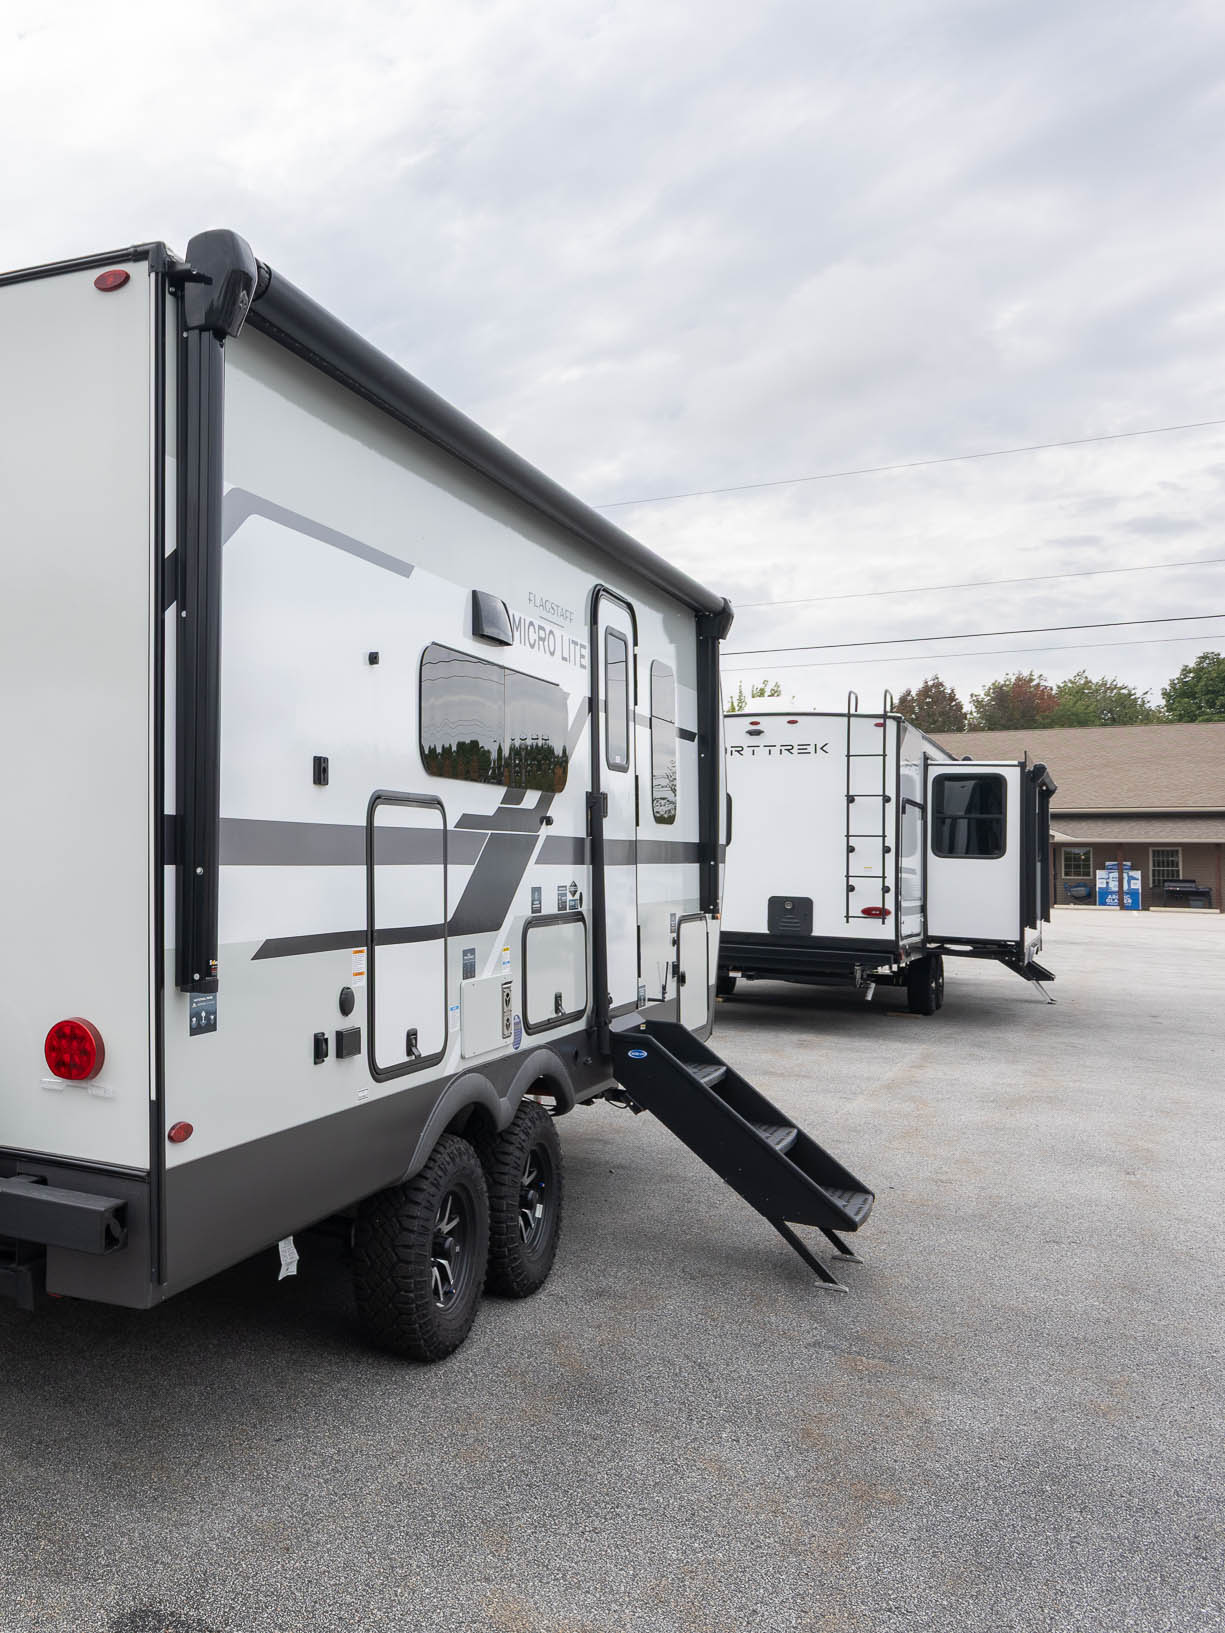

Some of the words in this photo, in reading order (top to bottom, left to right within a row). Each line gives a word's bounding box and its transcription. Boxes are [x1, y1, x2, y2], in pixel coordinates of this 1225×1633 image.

[528, 591, 575, 624] FLAGSTAFF
[512, 612, 556, 657] MICRO
[561, 634, 587, 670] LITE
[725, 743, 829, 757] RTTREK
